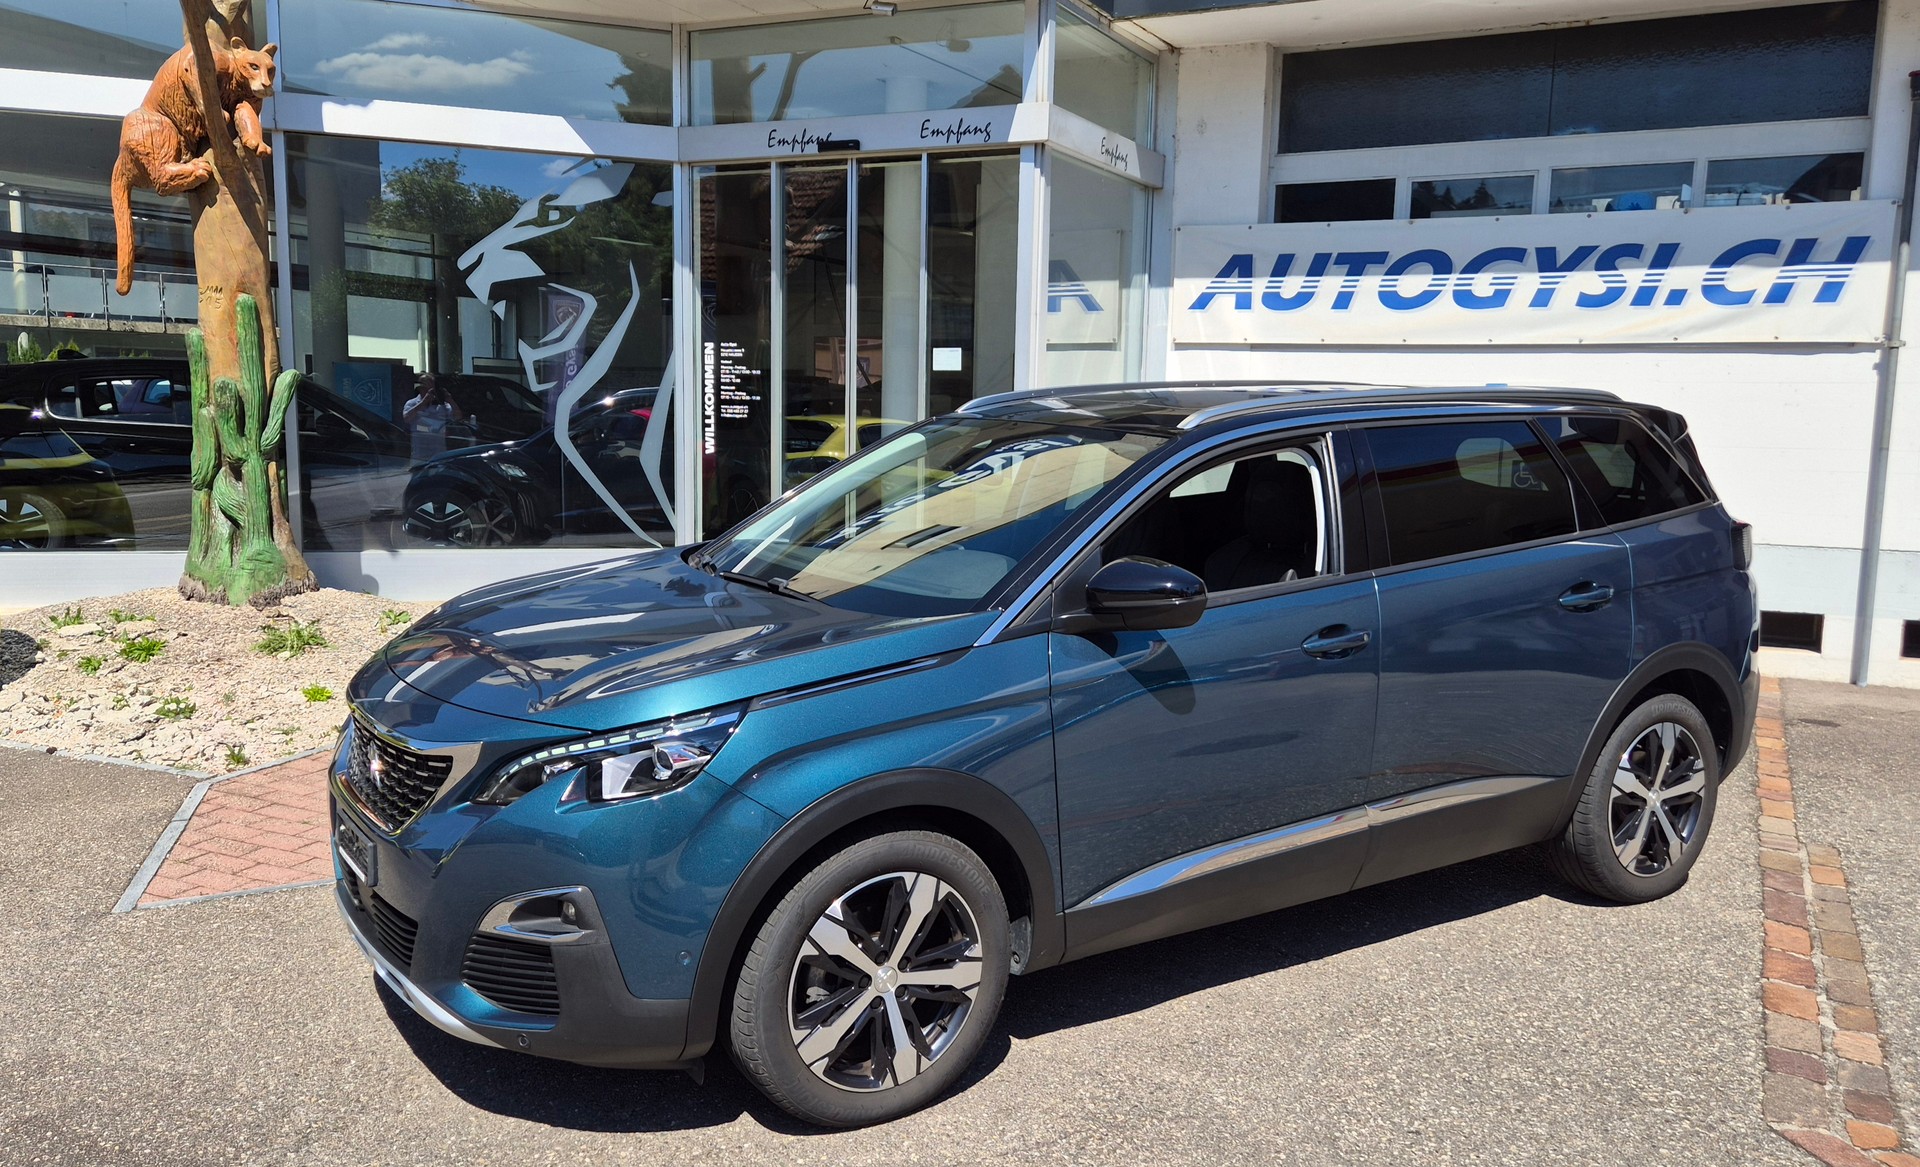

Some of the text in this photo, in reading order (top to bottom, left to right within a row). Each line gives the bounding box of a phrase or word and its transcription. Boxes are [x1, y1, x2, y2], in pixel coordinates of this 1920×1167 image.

[920, 118, 992, 143] Empfang
[1101, 137, 1128, 171] Empfang
[1188, 236, 1871, 313] AUTOGYSI.CH
[704, 342, 715, 454] WILLKOMMEN
[903, 842, 991, 897] BRIDGESTONE
